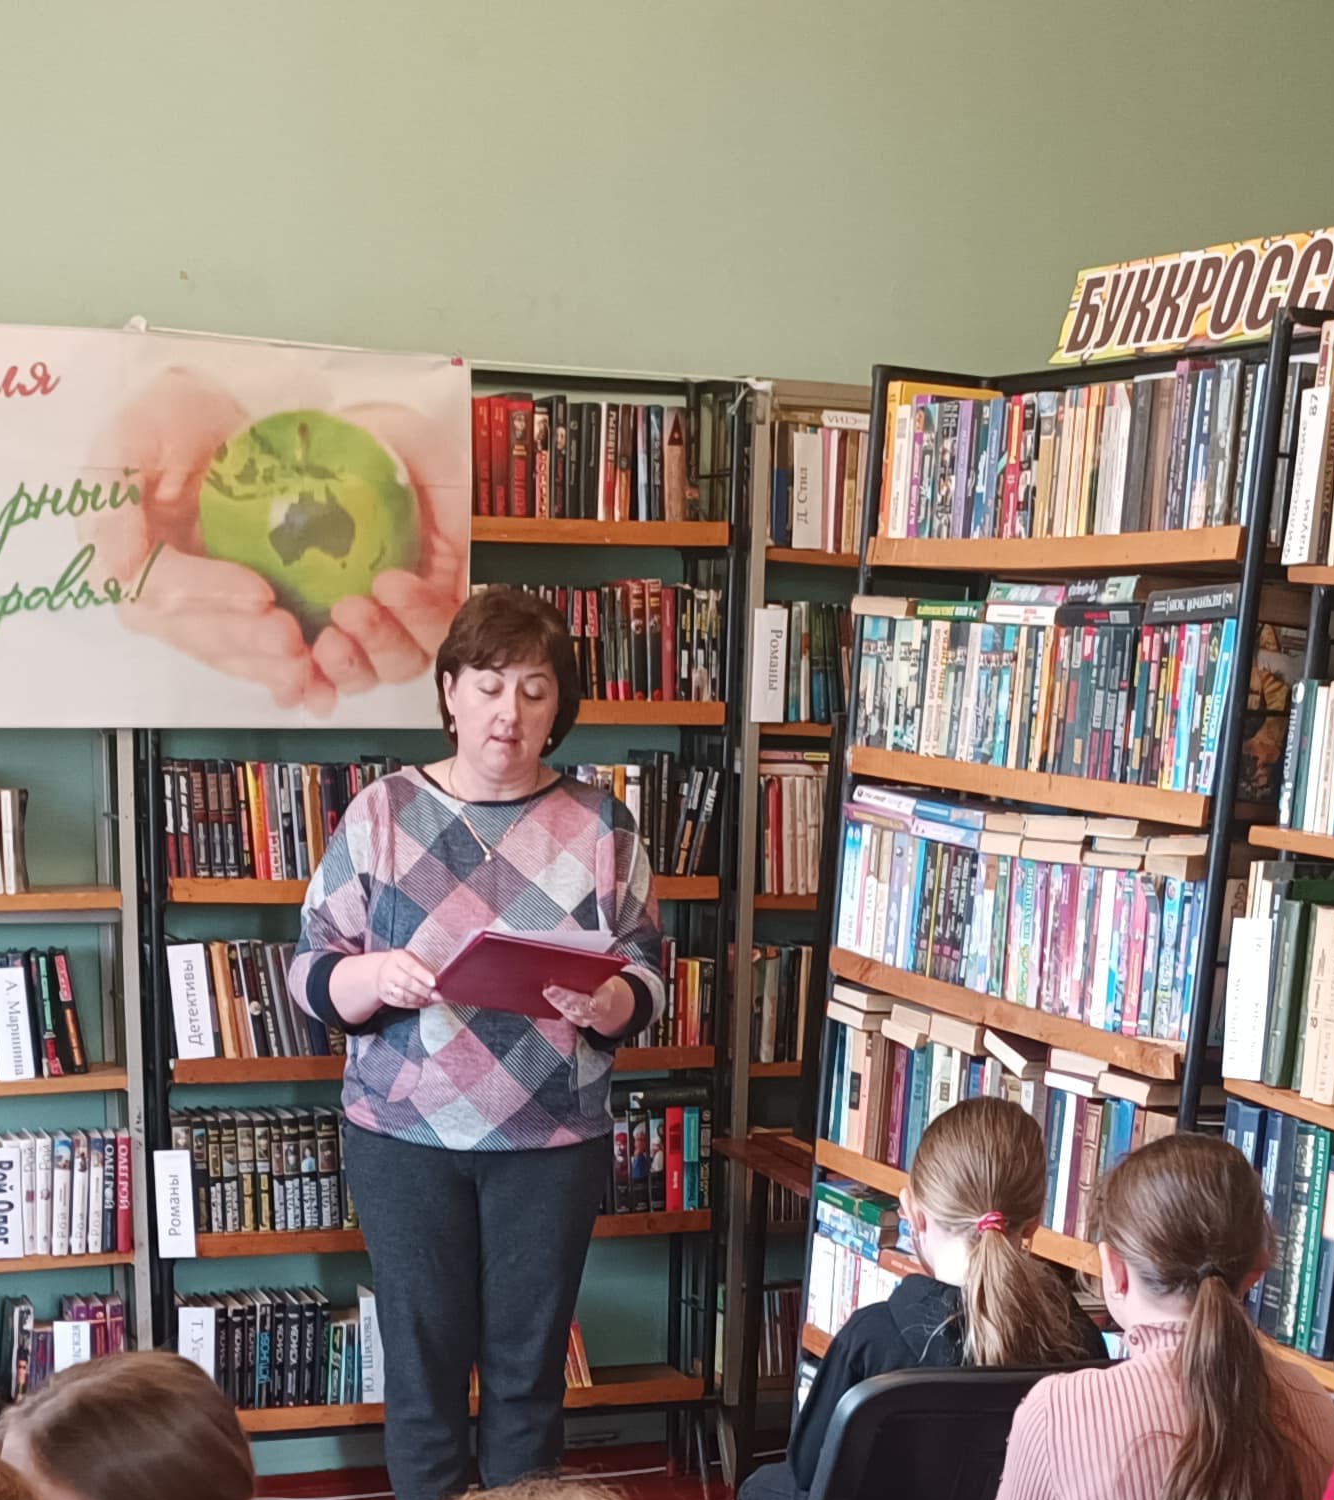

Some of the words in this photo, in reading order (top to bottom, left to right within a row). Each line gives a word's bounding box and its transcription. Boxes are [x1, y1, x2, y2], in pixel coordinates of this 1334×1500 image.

[1308, 394, 1319, 418] 87
[768, 628, 784, 692] Романы
[183, 959, 204, 1046] Детективы
[7, 1000, 25, 1077] Маринина
[104, 1144, 115, 1179] ОЛЕГ
[117, 1143, 130, 1179] ОЛЕГ
[118, 1180, 131, 1210] РОЙ
[168, 1173, 182, 1237] Романы
[362, 1316, 374, 1371] Шилова
